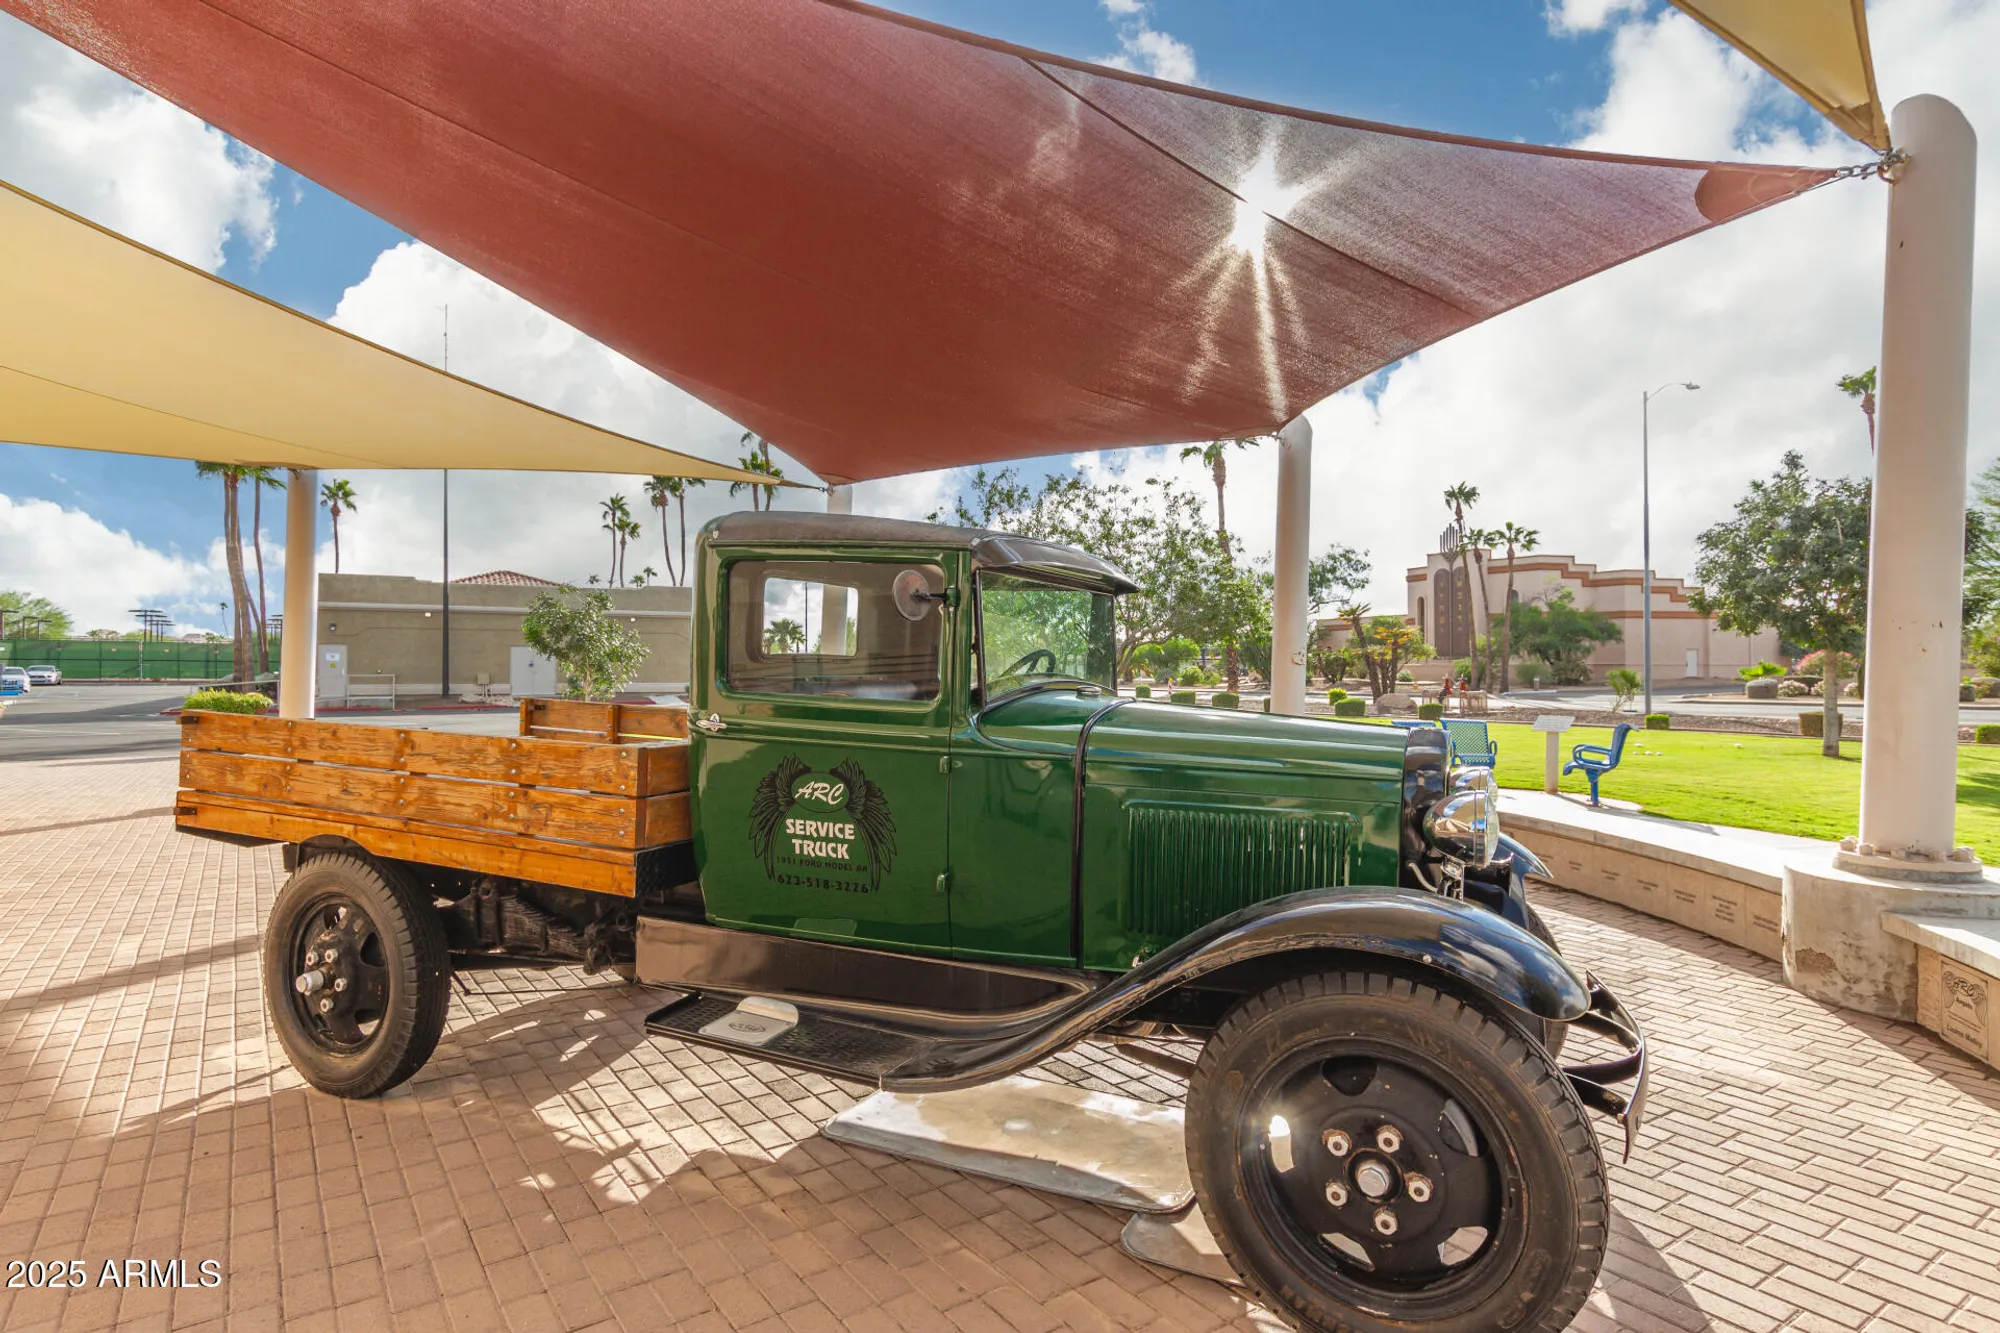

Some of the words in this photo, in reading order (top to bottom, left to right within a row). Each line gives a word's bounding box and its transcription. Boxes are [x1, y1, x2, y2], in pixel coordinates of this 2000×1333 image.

[794, 780, 844, 805] ARC
[785, 818, 855, 840] SERVICE
[791, 838, 850, 859] TRUCK
[799, 858, 822, 868] FORD
[824, 861, 853, 872] MODEL
